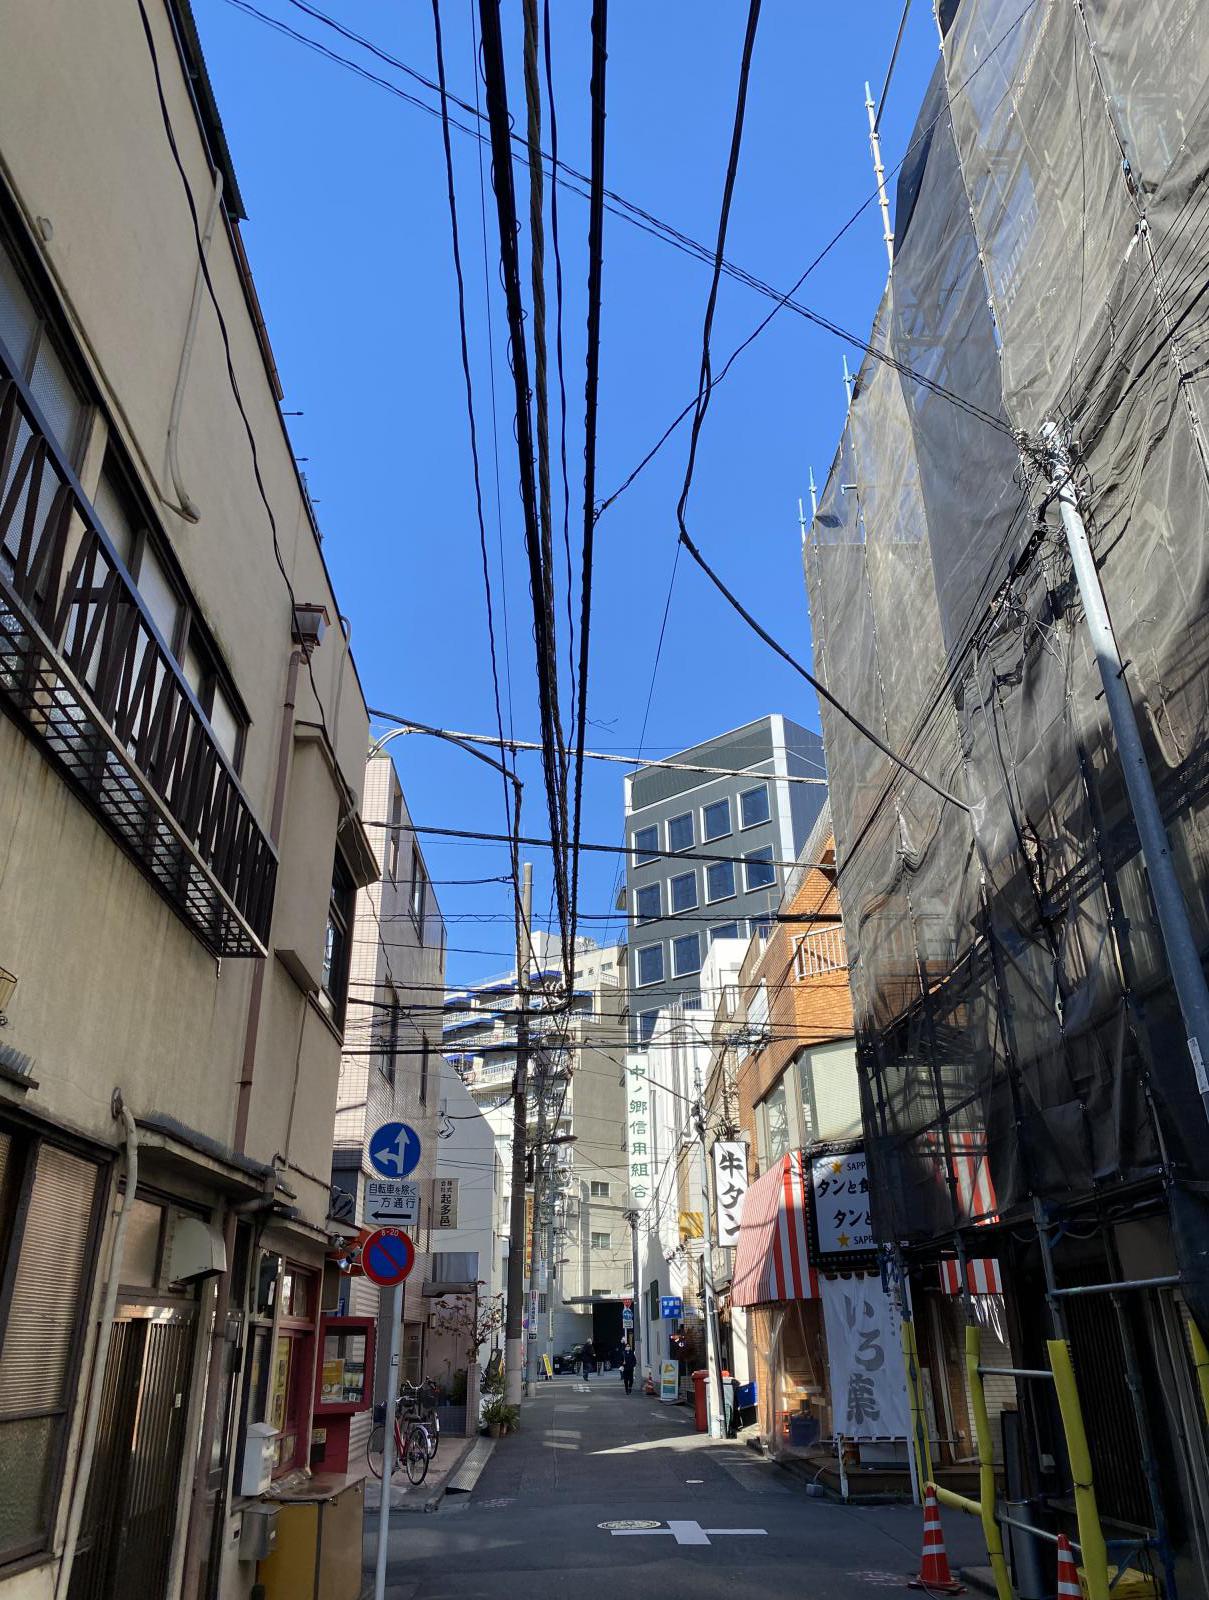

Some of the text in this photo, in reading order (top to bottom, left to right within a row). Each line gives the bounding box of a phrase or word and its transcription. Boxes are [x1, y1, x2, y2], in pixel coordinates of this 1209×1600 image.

[629, 1064, 650, 1199] 中ノ郷信用組合
[369, 1183, 417, 1196] 自転車を除く
[369, 1197, 417, 1209] 一方通行
[718, 1150, 745, 1237] 牛タン
[844, 1294, 885, 1425] いろ葉
